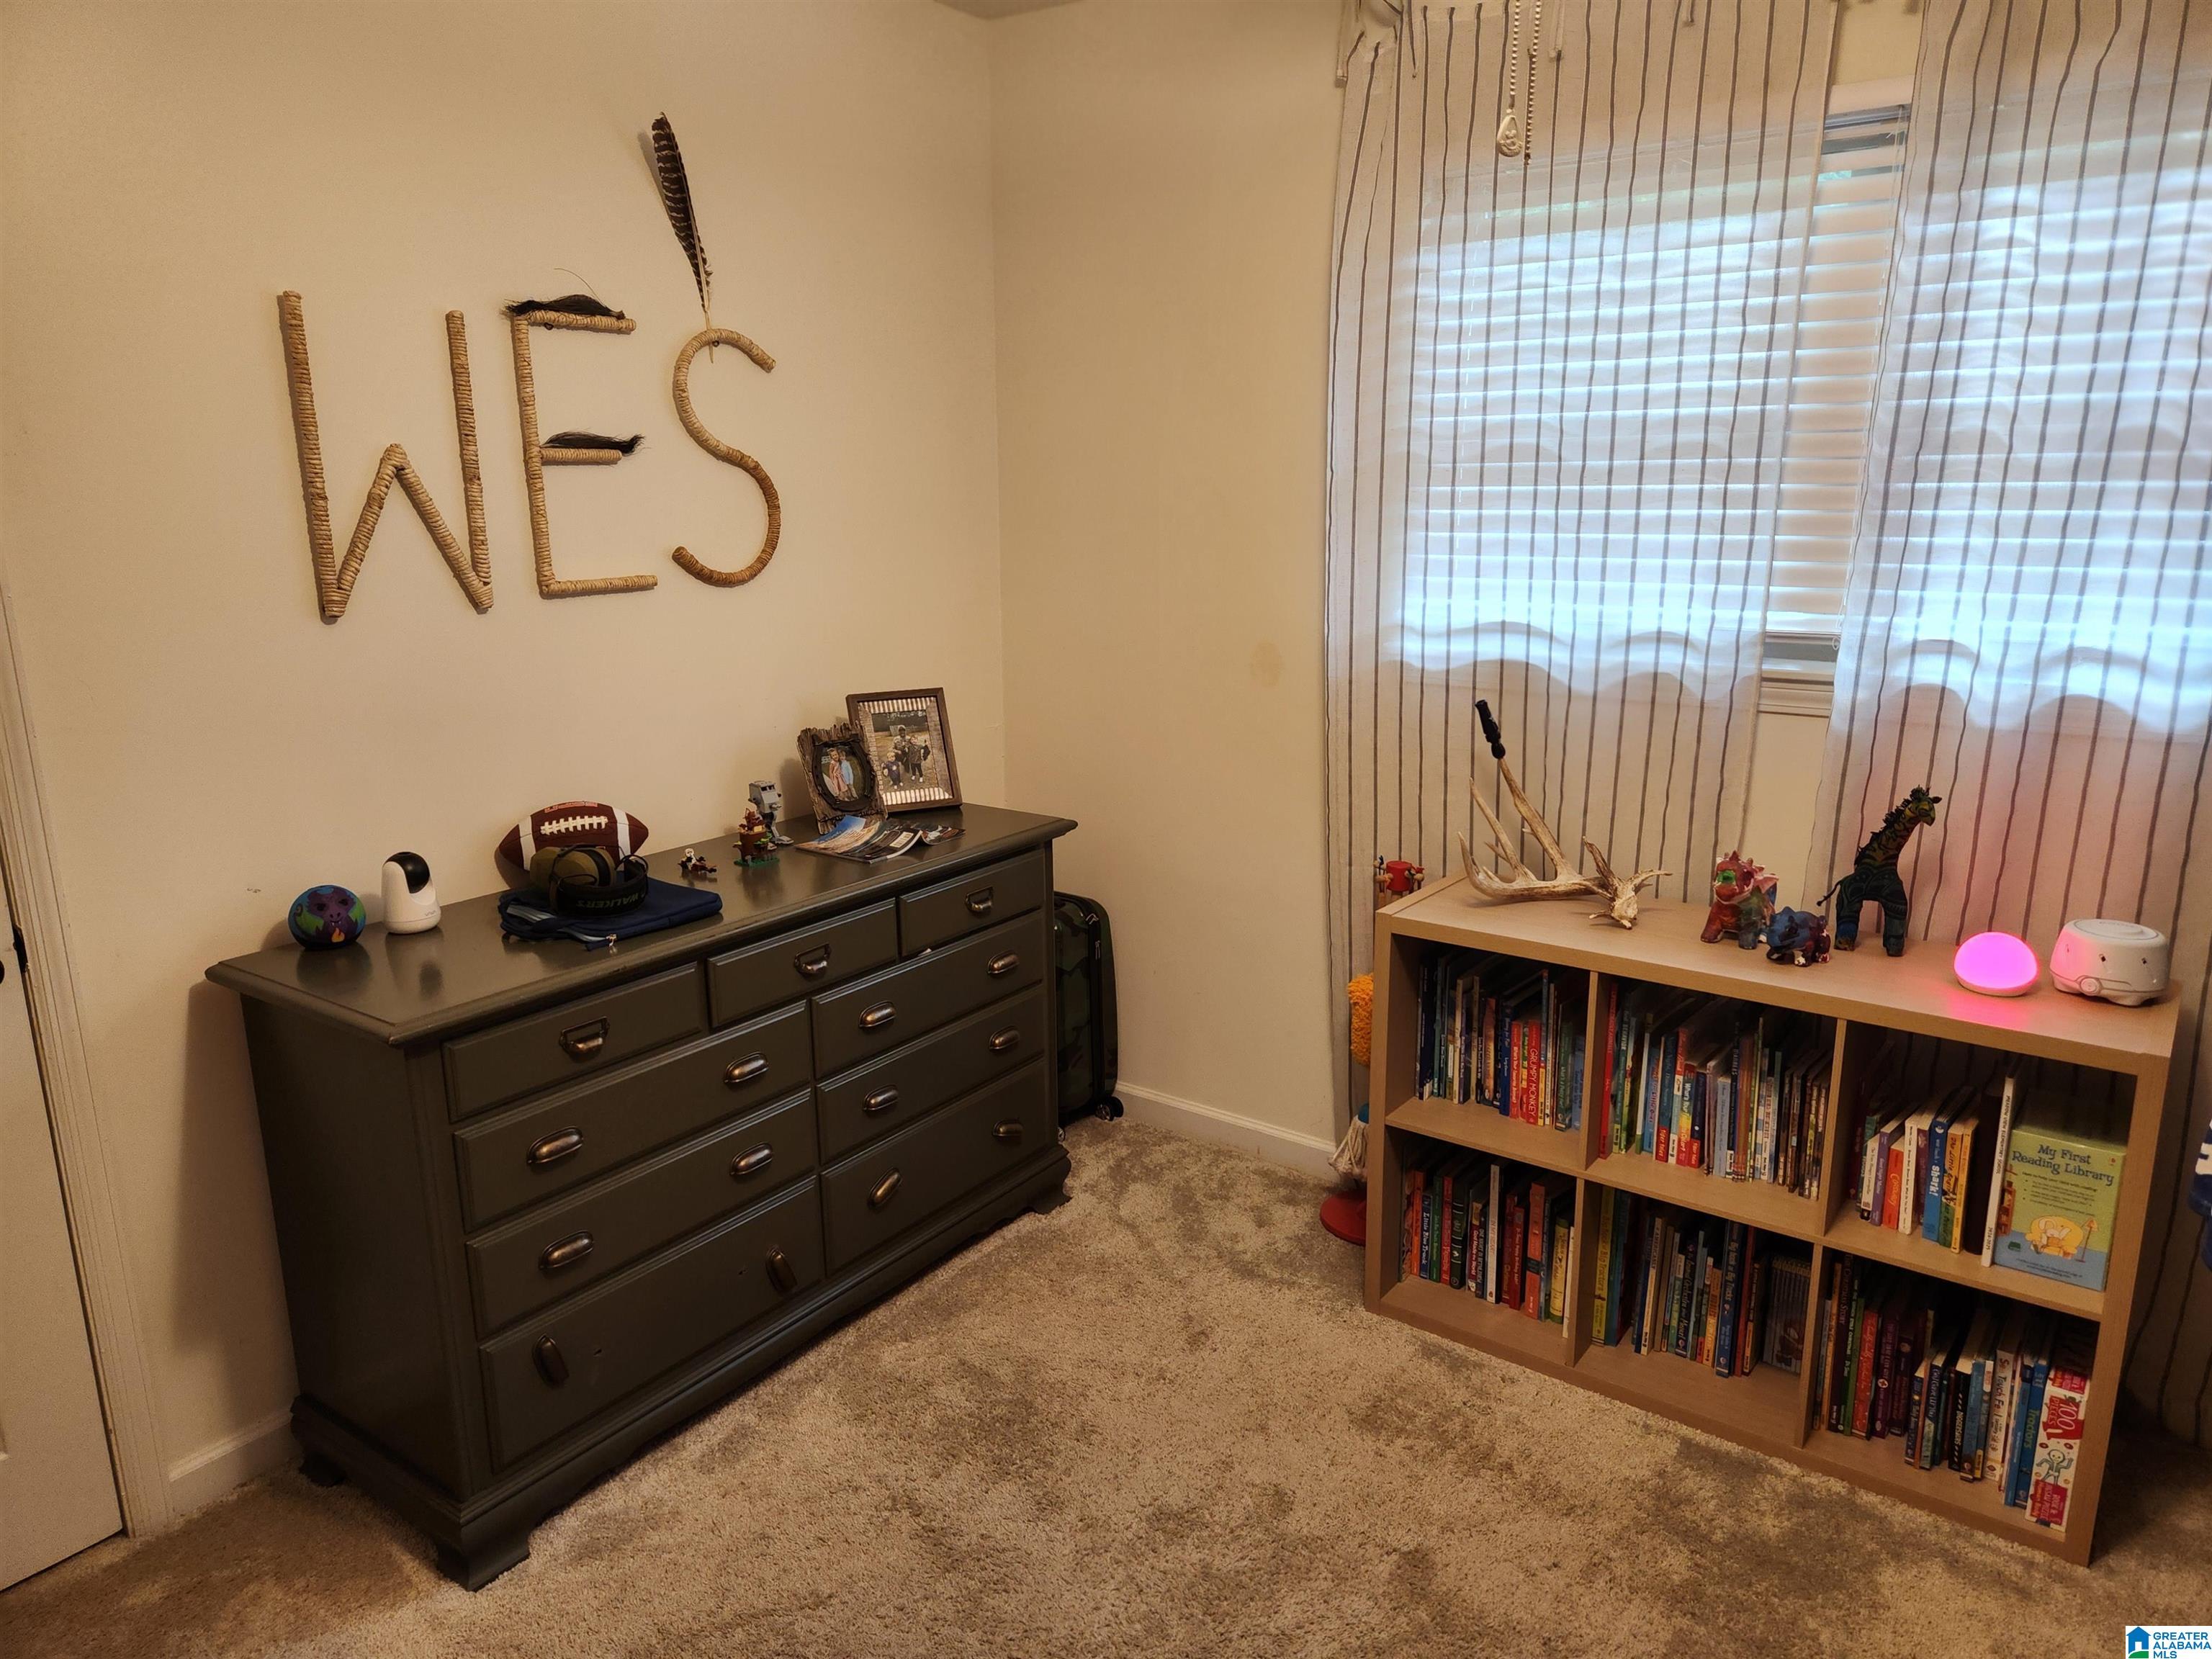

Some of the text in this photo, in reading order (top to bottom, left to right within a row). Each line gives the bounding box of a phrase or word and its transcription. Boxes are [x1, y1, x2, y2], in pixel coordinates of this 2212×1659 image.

[283, 290, 781, 618] WES
[1528, 1048, 1538, 1117] GRUMPY MONKEY
[1682, 1083, 1691, 1099] What's
[1681, 1101, 1690, 1113] Your
[2002, 1096, 2011, 1115] MEADOW
[2038, 1144, 2091, 1164] My First
[2013, 1151, 2114, 1186] Reading Library
[1929, 1165, 1940, 1196] shark!
[1729, 1241, 1739, 1251] Big
[1598, 1264, 1607, 1291] Tractors
[1726, 1272, 1735, 1281] Big
[1725, 1282, 1735, 1301] Trucks
[1996, 1376, 2006, 1396] Touch
[2048, 1398, 2059, 1426] PIECES
[2057, 1402, 2077, 1431] 100
[2024, 1409, 2039, 1449] Tractors
[2039, 1502, 2049, 1520] PUZZLE
[2051, 1494, 2060, 1509] BOOK
